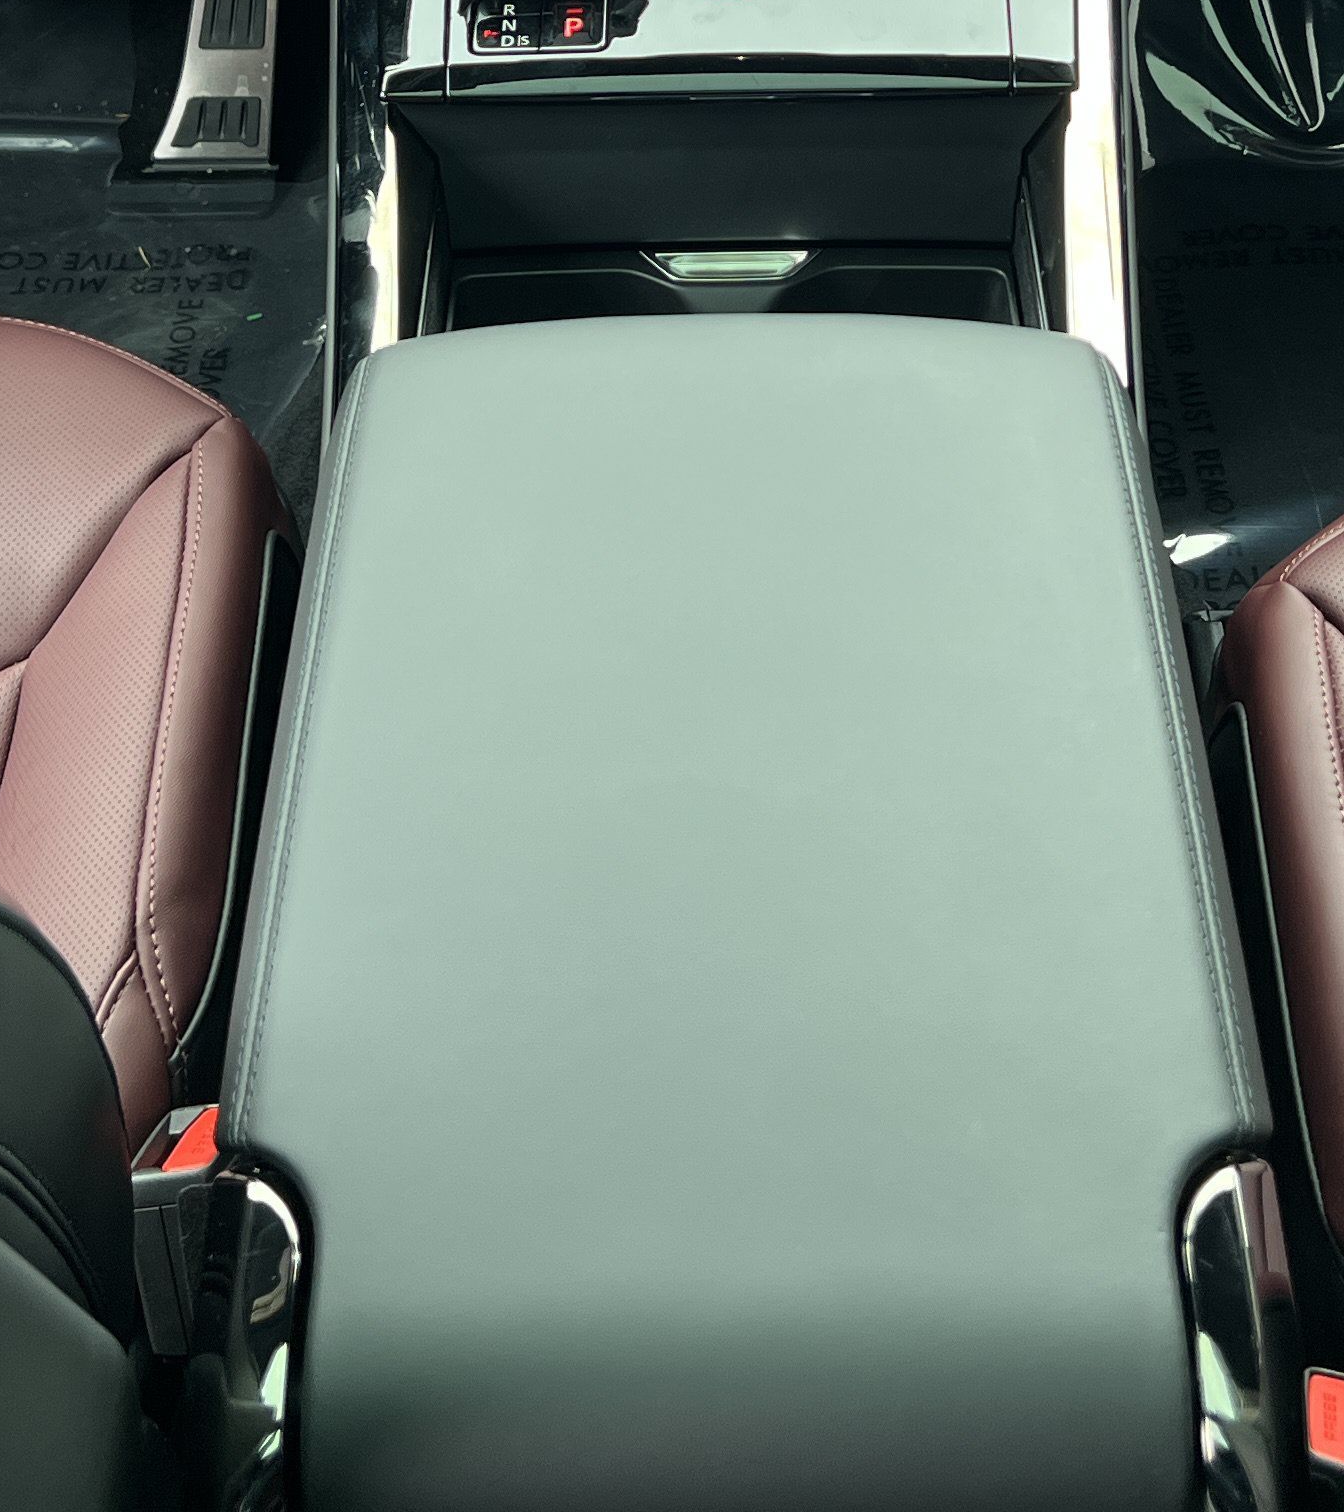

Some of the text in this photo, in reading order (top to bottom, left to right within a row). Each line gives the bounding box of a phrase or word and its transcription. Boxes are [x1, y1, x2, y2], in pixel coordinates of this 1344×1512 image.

[503, 4, 516, 16] R
[501, 19, 517, 32] N
[563, 17, 584, 38] P
[8, 276, 108, 295] MUST
[129, 268, 253, 294] DEALER
[161, 299, 204, 377] EMOVE
[1172, 369, 1218, 436] MUST
